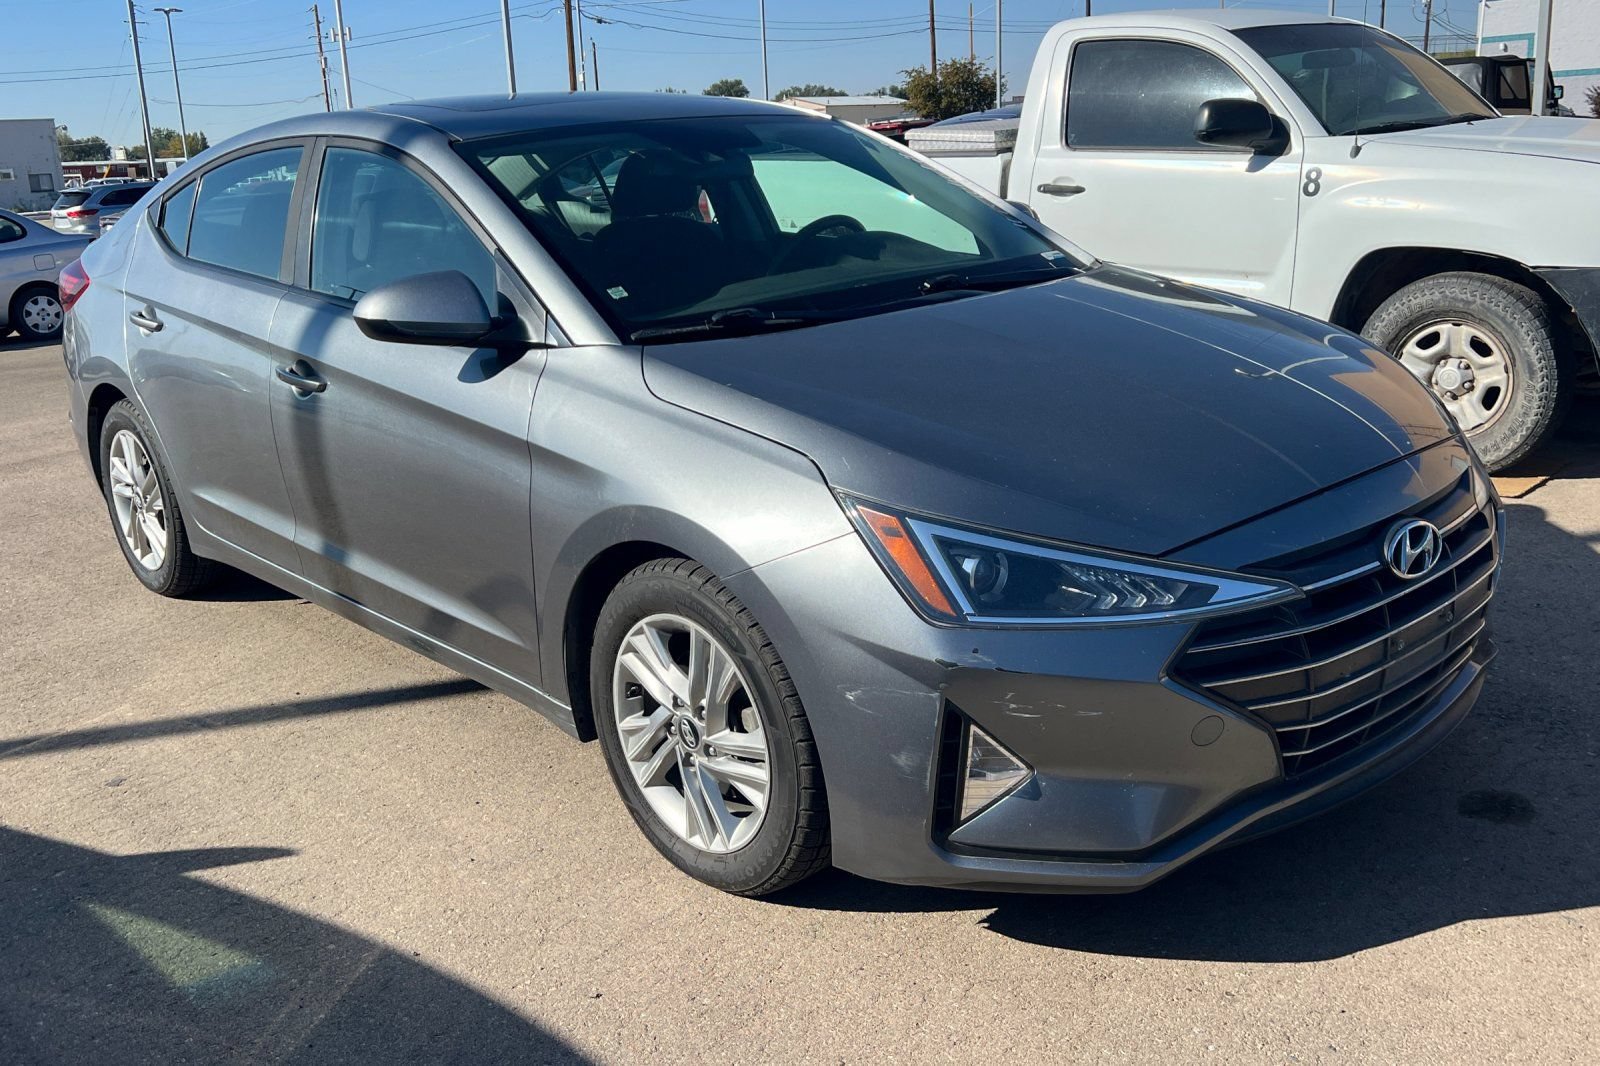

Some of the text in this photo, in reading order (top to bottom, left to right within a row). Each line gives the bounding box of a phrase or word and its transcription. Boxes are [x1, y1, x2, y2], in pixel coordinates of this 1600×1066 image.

[1303, 167, 1322, 197] 8
[1384, 298, 1434, 335] RANGE
[1479, 415, 1525, 456] TERRA
